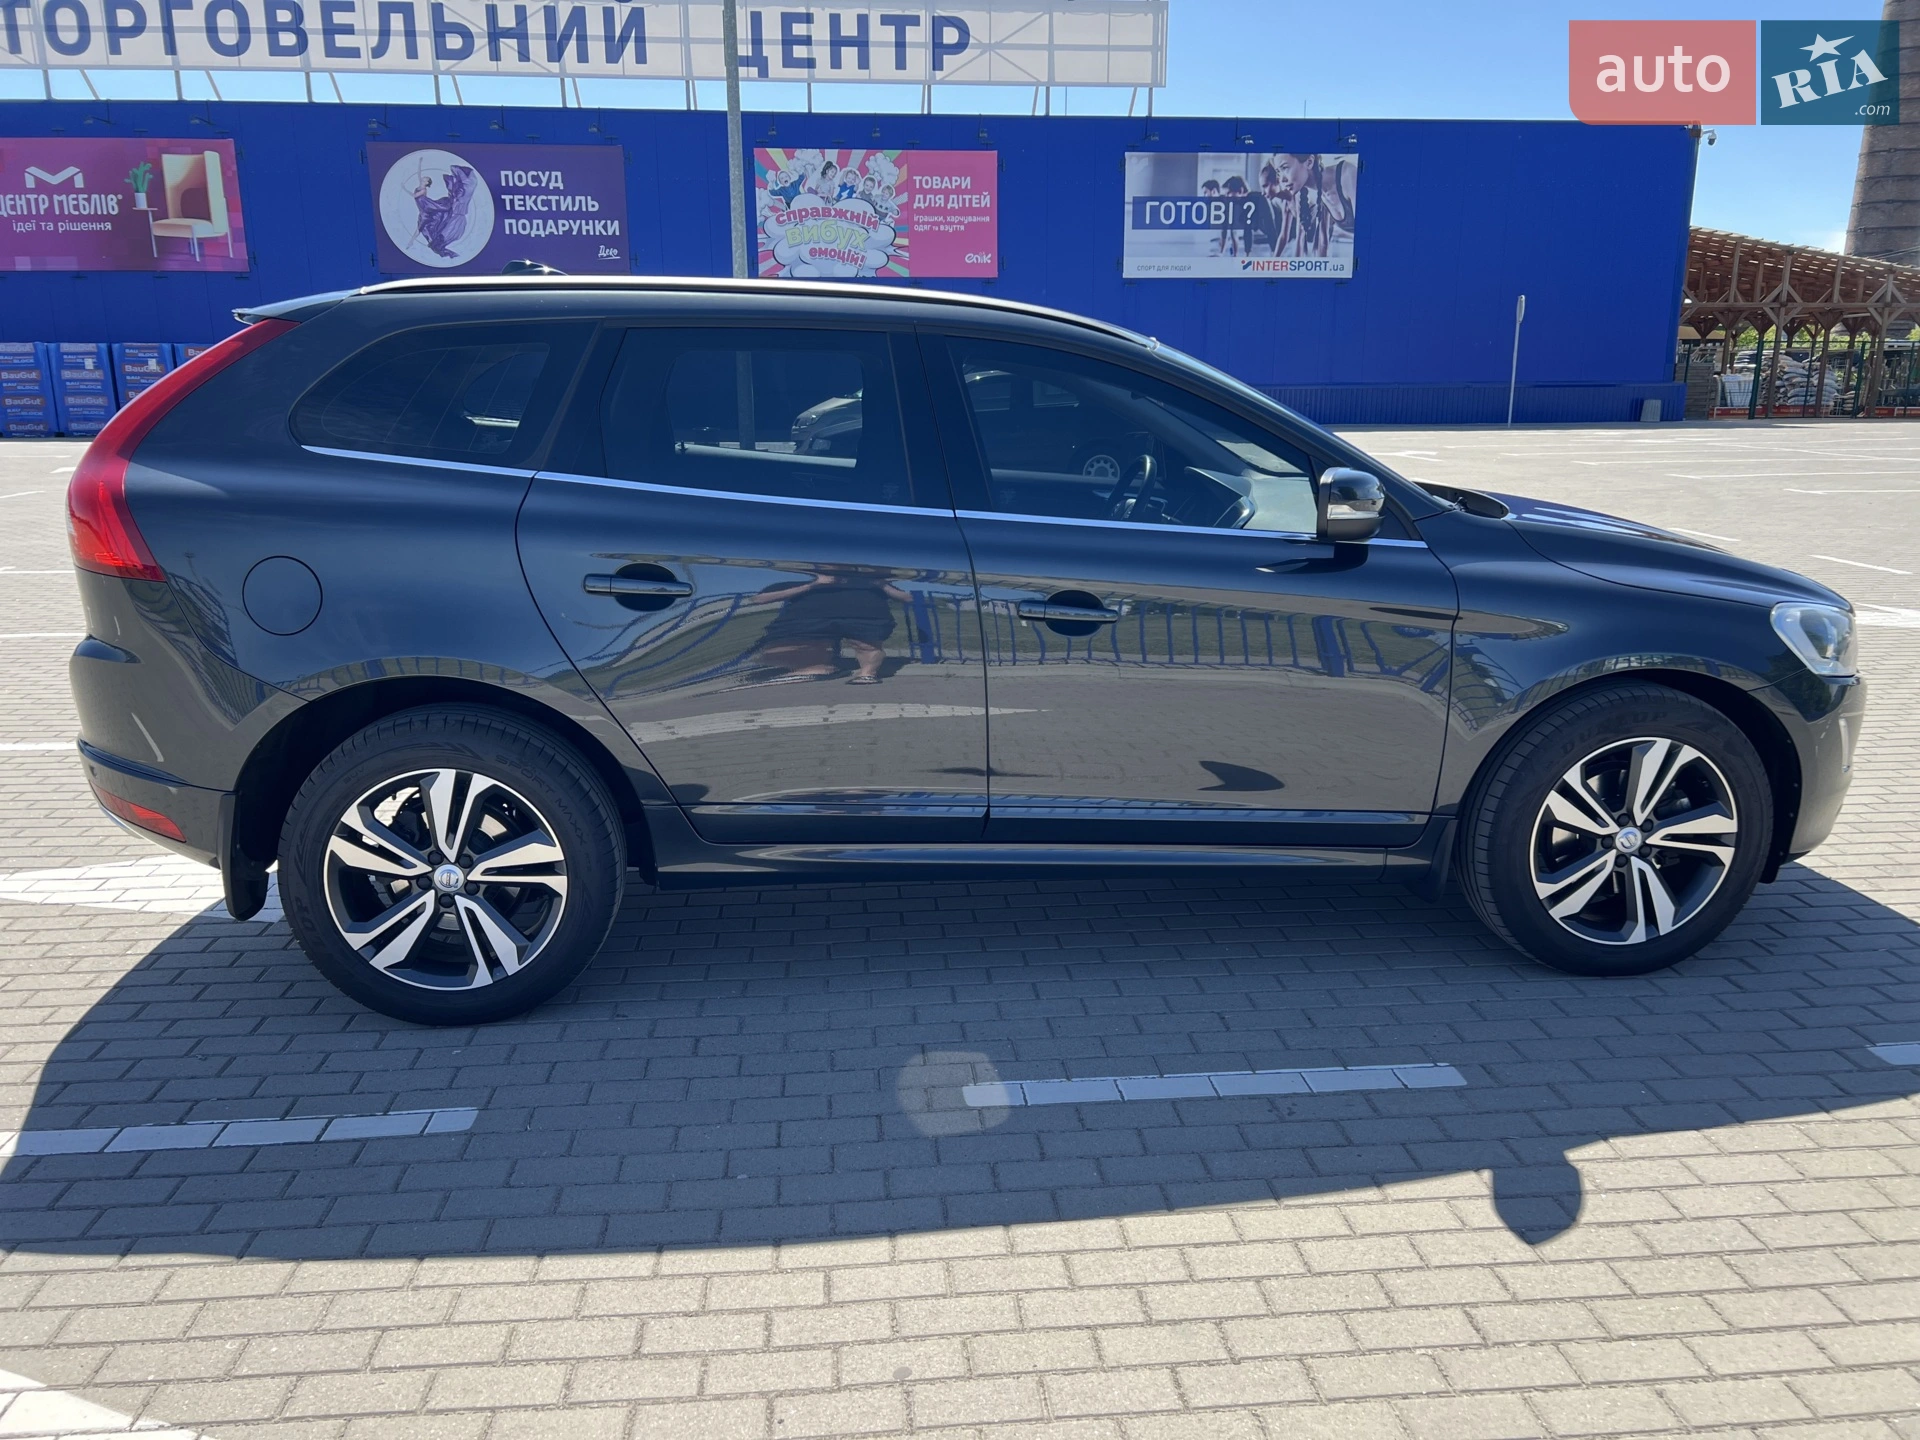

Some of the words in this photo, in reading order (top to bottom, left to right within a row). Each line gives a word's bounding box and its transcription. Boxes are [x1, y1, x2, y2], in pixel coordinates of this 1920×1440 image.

[0, 0, 647, 65] ТОРГОВЕЛЬНИЙ
[723, 10, 970, 78] ЦЕНТР
[500, 170, 564, 190] ПОСУД
[913, 176, 971, 190] ТОВАРИ
[53, 194, 119, 215] МЕБЛІВ
[501, 195, 600, 212] ТЕКСТИЛЬ
[913, 194, 945, 209] ДЛЯ
[947, 192, 991, 209] ДІТЕЙ
[775, 206, 880, 231] справжній
[914, 214, 946, 223] іграшки,
[947, 215, 990, 224] харчування
[1145, 201, 1234, 225] ГОТОВІ
[1242, 201, 1256, 225] ?
[12, 219, 36, 233] ідеї
[39, 222, 54, 231] та
[58, 219, 112, 233] рішення
[504, 219, 620, 238] ПОДАРУНКИ
[785, 220, 870, 248] вибух
[940, 225, 965, 233] взуття
[809, 247, 866, 269] емоцій!
[1252, 260, 1345, 272] INTERSPORT.ua
[1, 371, 37, 379] BauGut
[71, 422, 105, 430] BauGu
